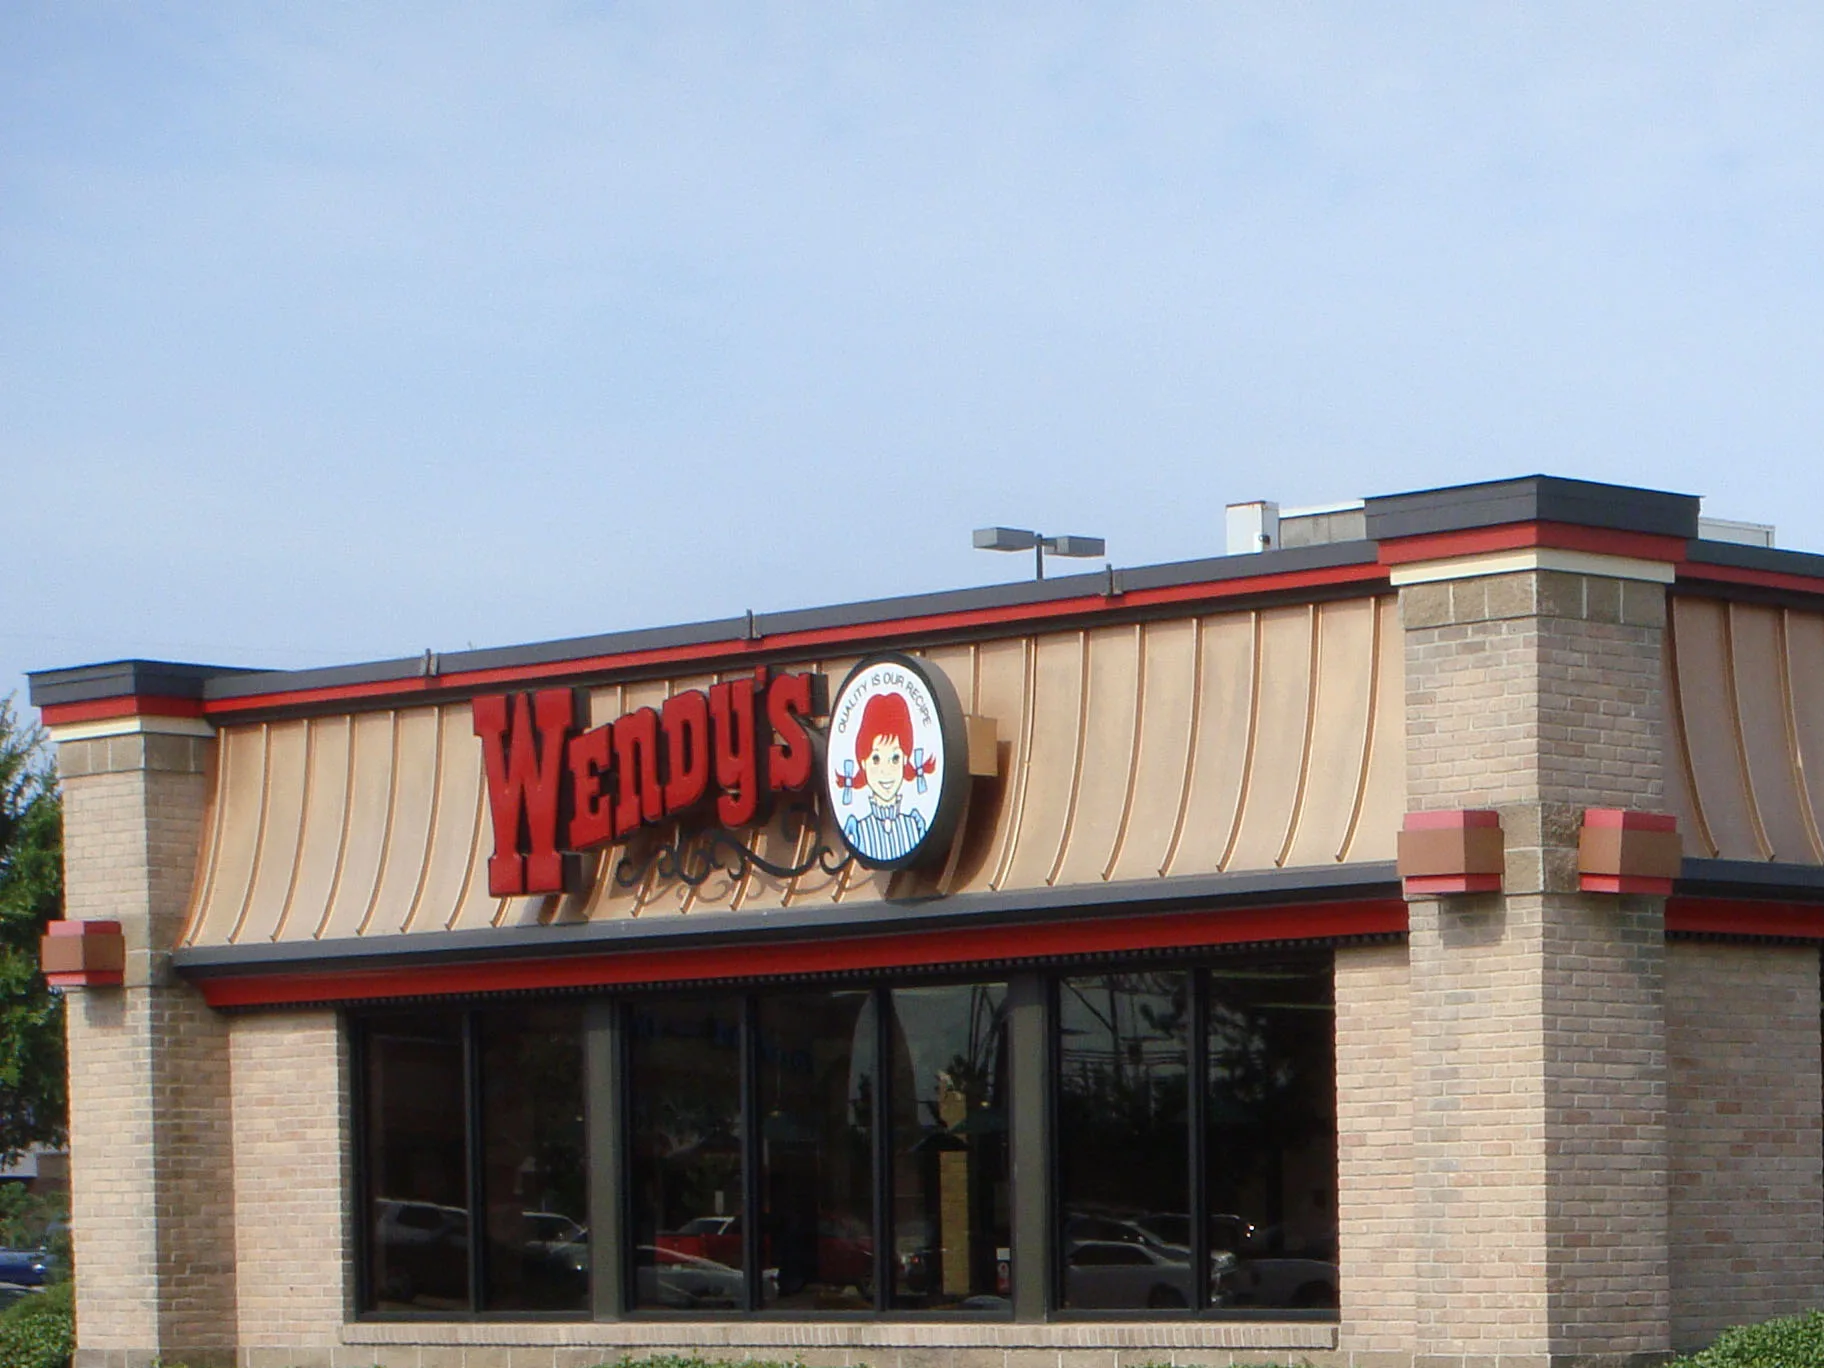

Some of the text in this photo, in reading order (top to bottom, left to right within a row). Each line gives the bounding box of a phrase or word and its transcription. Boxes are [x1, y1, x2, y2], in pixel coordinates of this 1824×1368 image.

[838, 671, 932, 734] QUALITY IS OUR RECIPE
